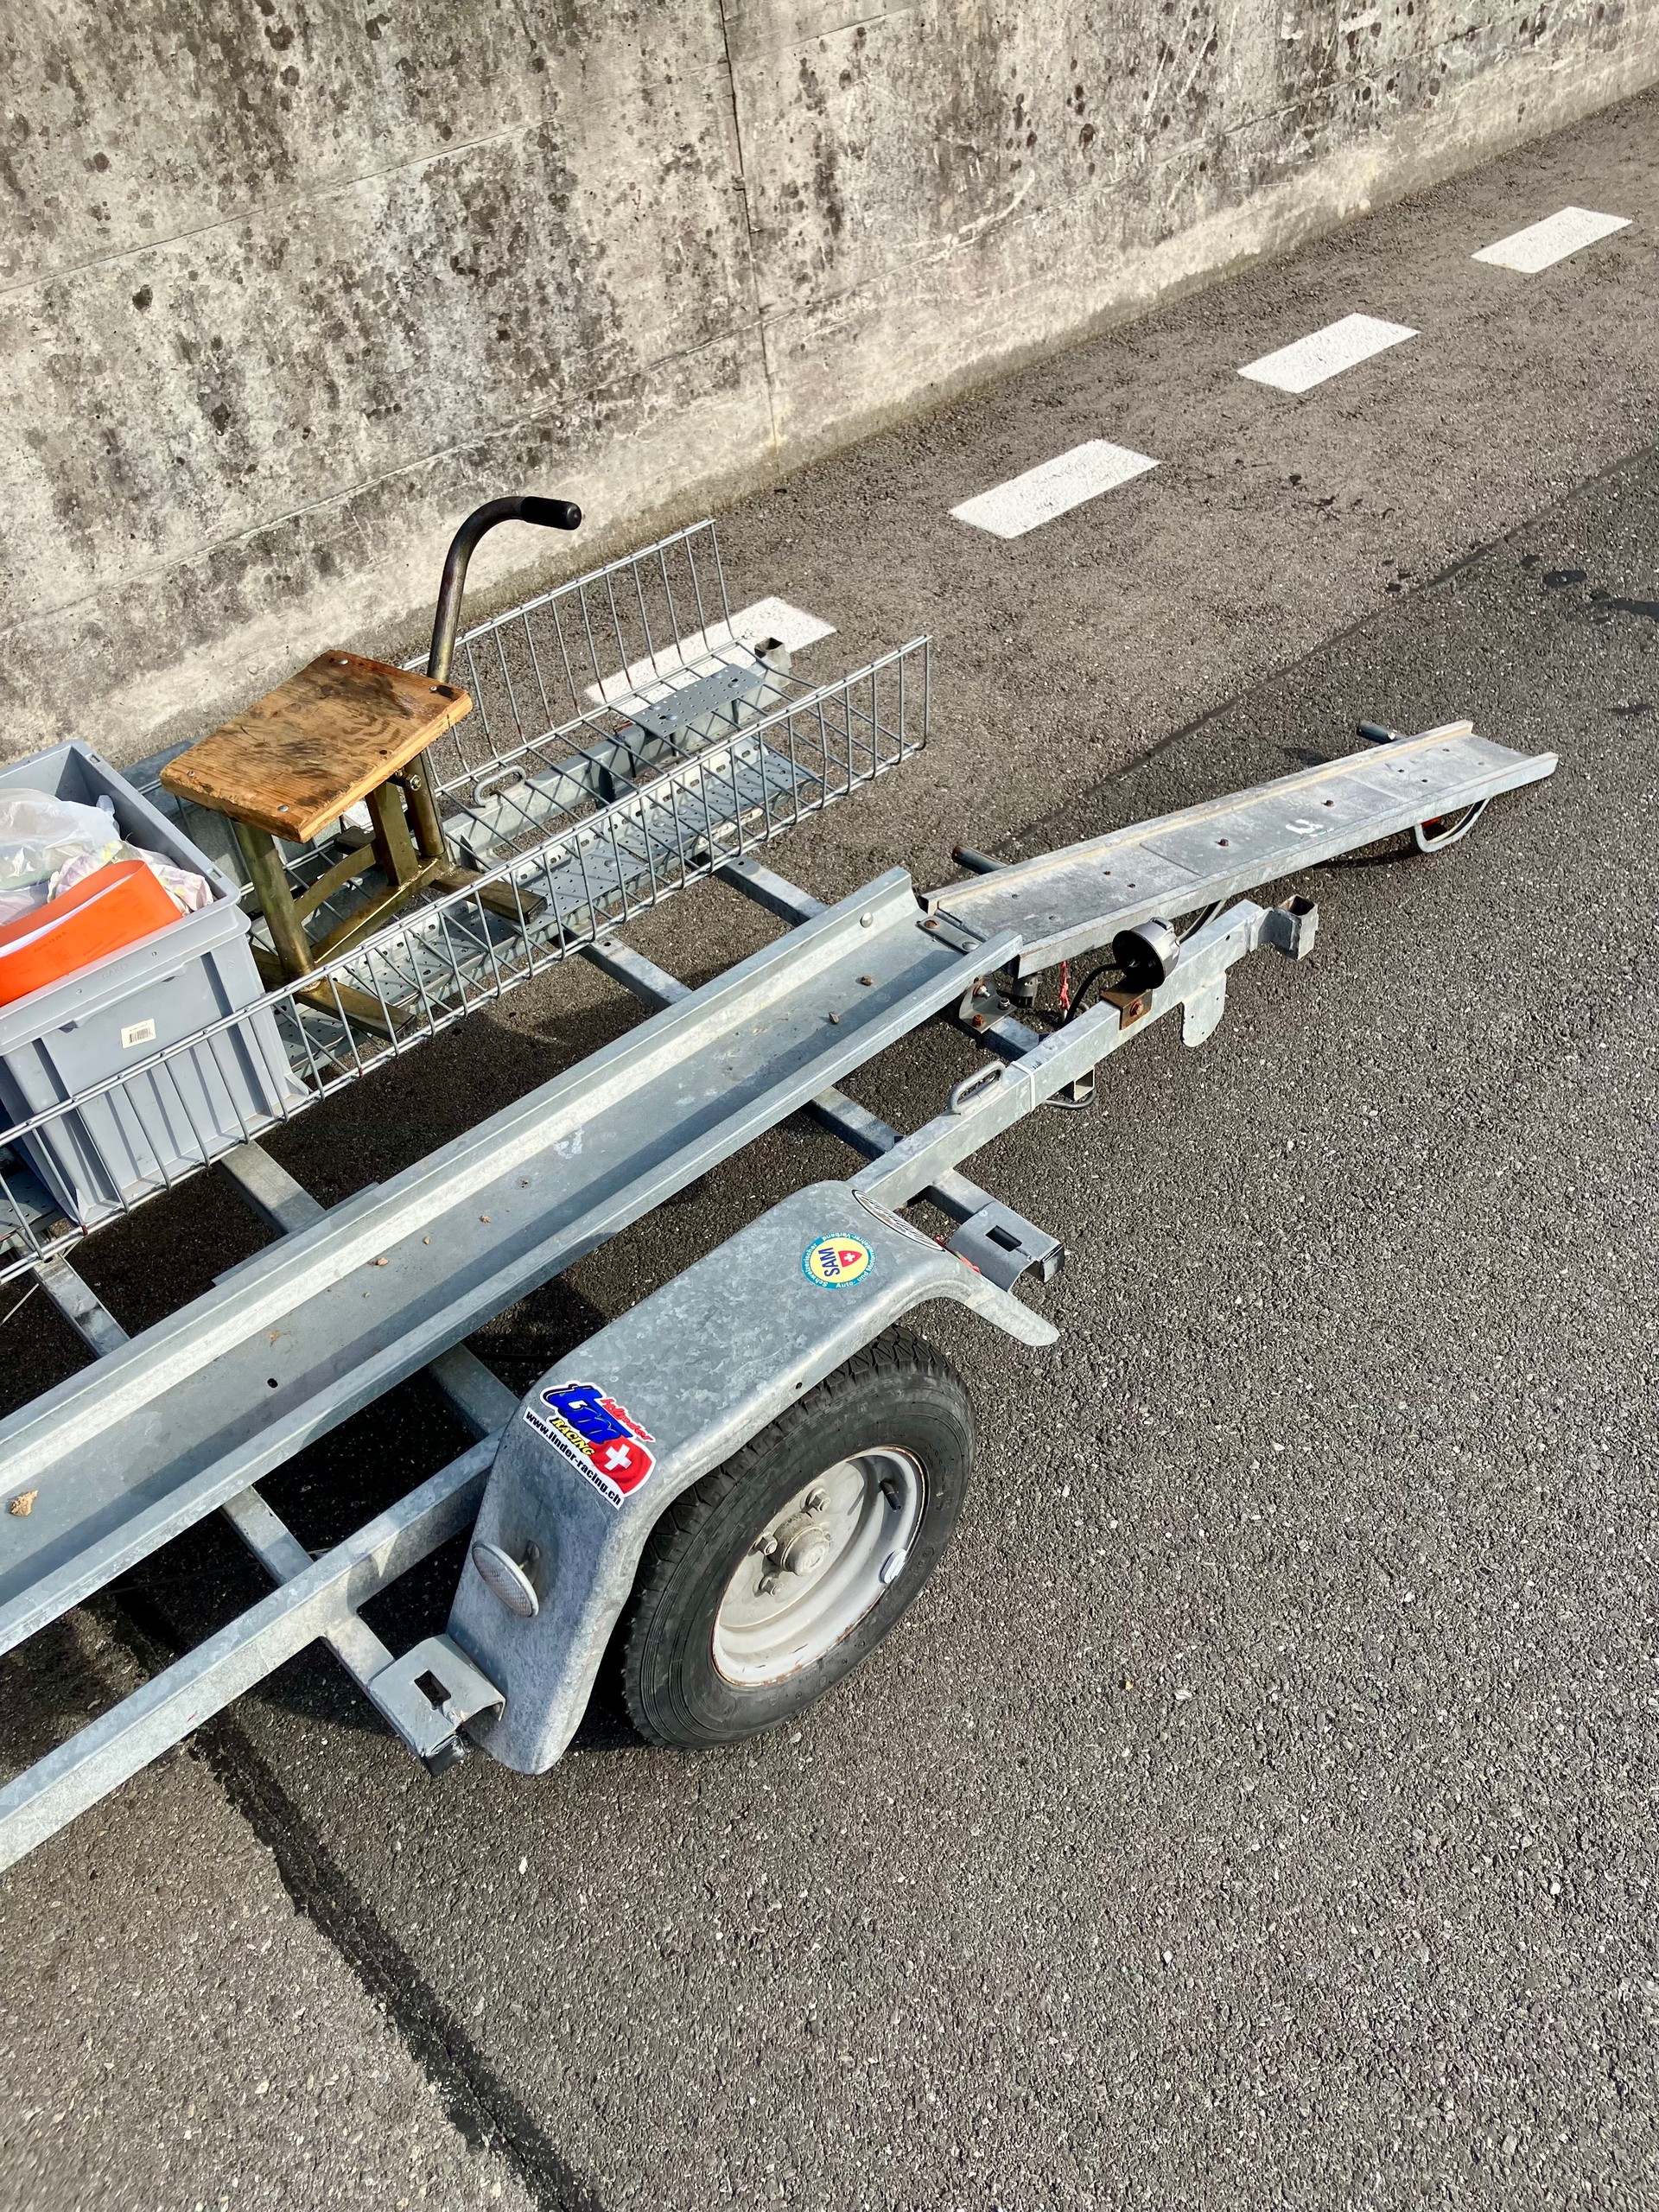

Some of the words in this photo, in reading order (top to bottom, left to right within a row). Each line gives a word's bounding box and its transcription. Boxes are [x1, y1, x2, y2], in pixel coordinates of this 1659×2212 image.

[804, 1243, 829, 1287] Schweizerischer
[817, 1247, 841, 1277] SAM
[549, 1417, 594, 1456] RACING
[525, 1411, 621, 1505] www.linder-racing.ch
